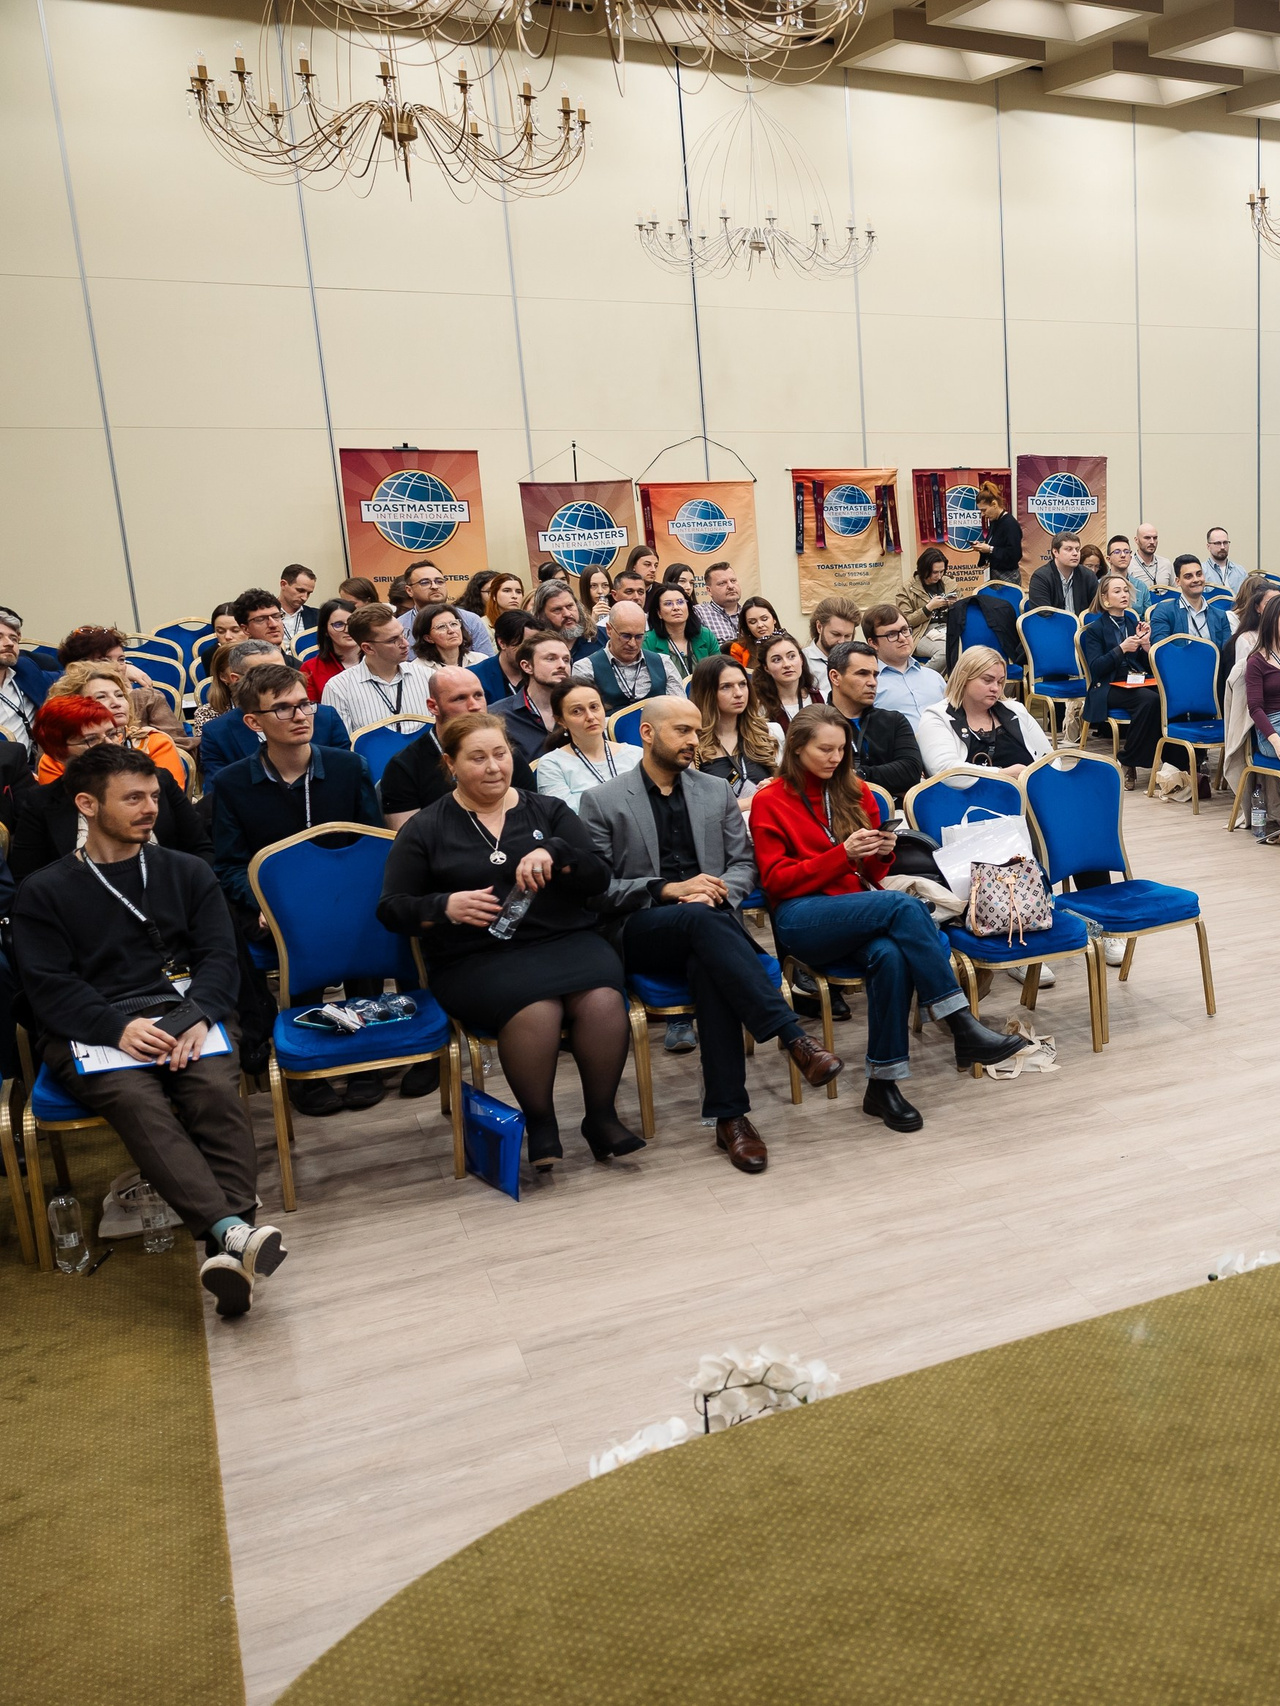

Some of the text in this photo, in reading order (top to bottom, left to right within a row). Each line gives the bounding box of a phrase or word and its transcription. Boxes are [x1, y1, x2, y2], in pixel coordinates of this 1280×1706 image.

[365, 504, 465, 512] TOASTMASTERS
[671, 520, 733, 528] TOASTMASTERS
[542, 530, 624, 542] TOASTMASTERS
[552, 540, 616, 548] INTERNATIONAL
